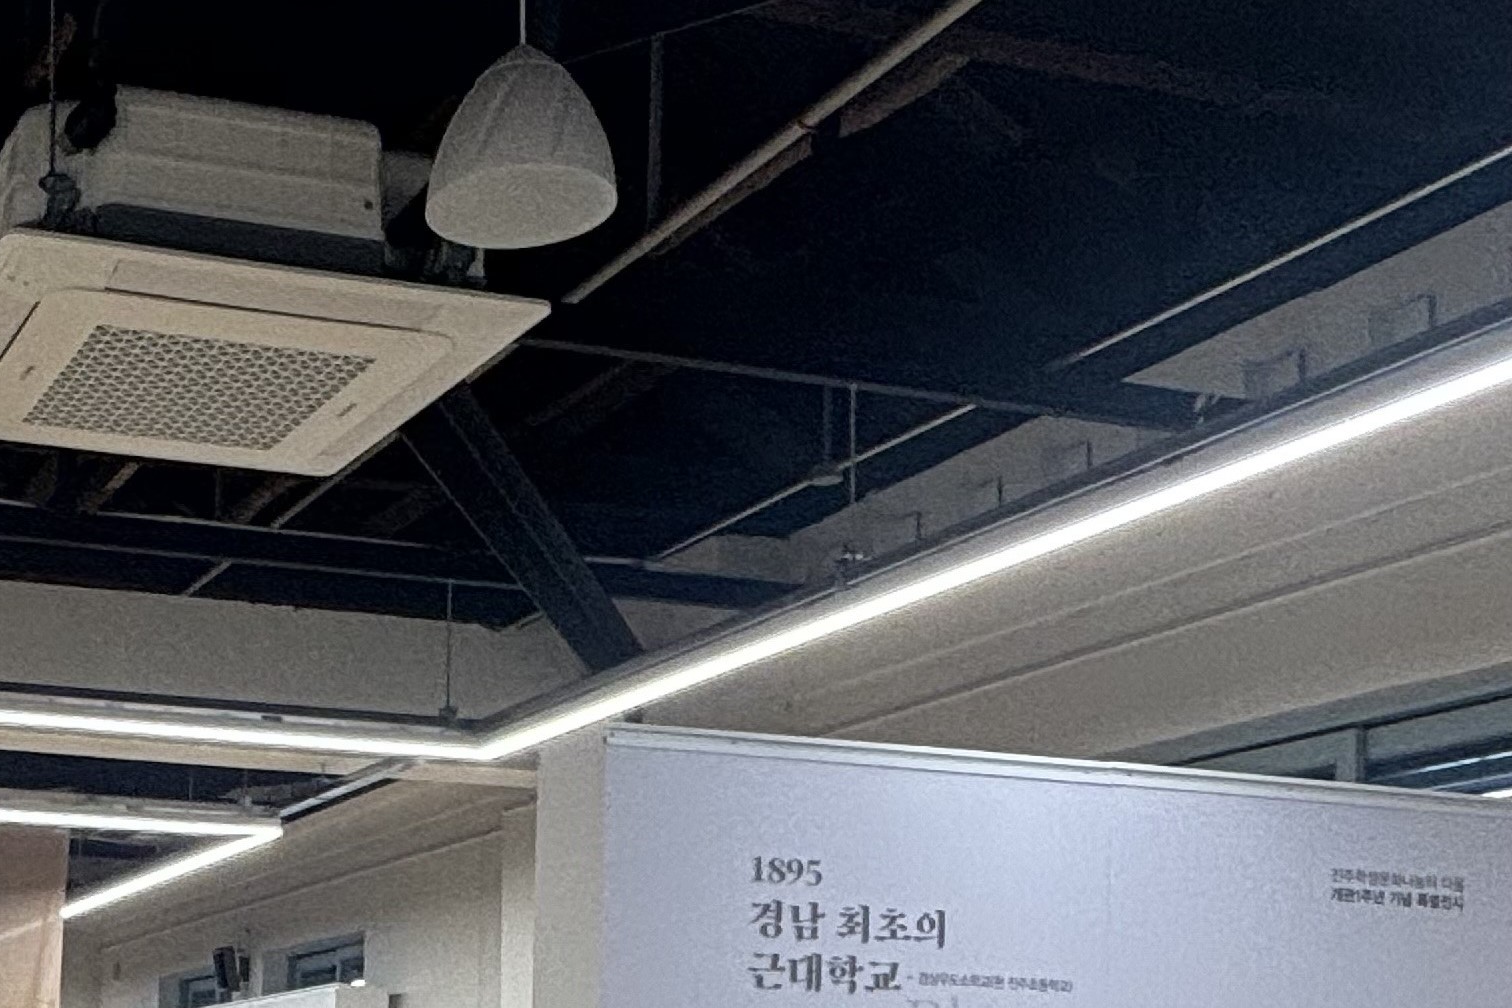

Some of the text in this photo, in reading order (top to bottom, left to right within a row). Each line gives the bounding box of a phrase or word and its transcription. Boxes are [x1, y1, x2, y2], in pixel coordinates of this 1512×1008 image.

[751, 855, 823, 886] 1895
[750, 899, 946, 950] 경남 최초의
[747, 952, 902, 994] 근대학교
